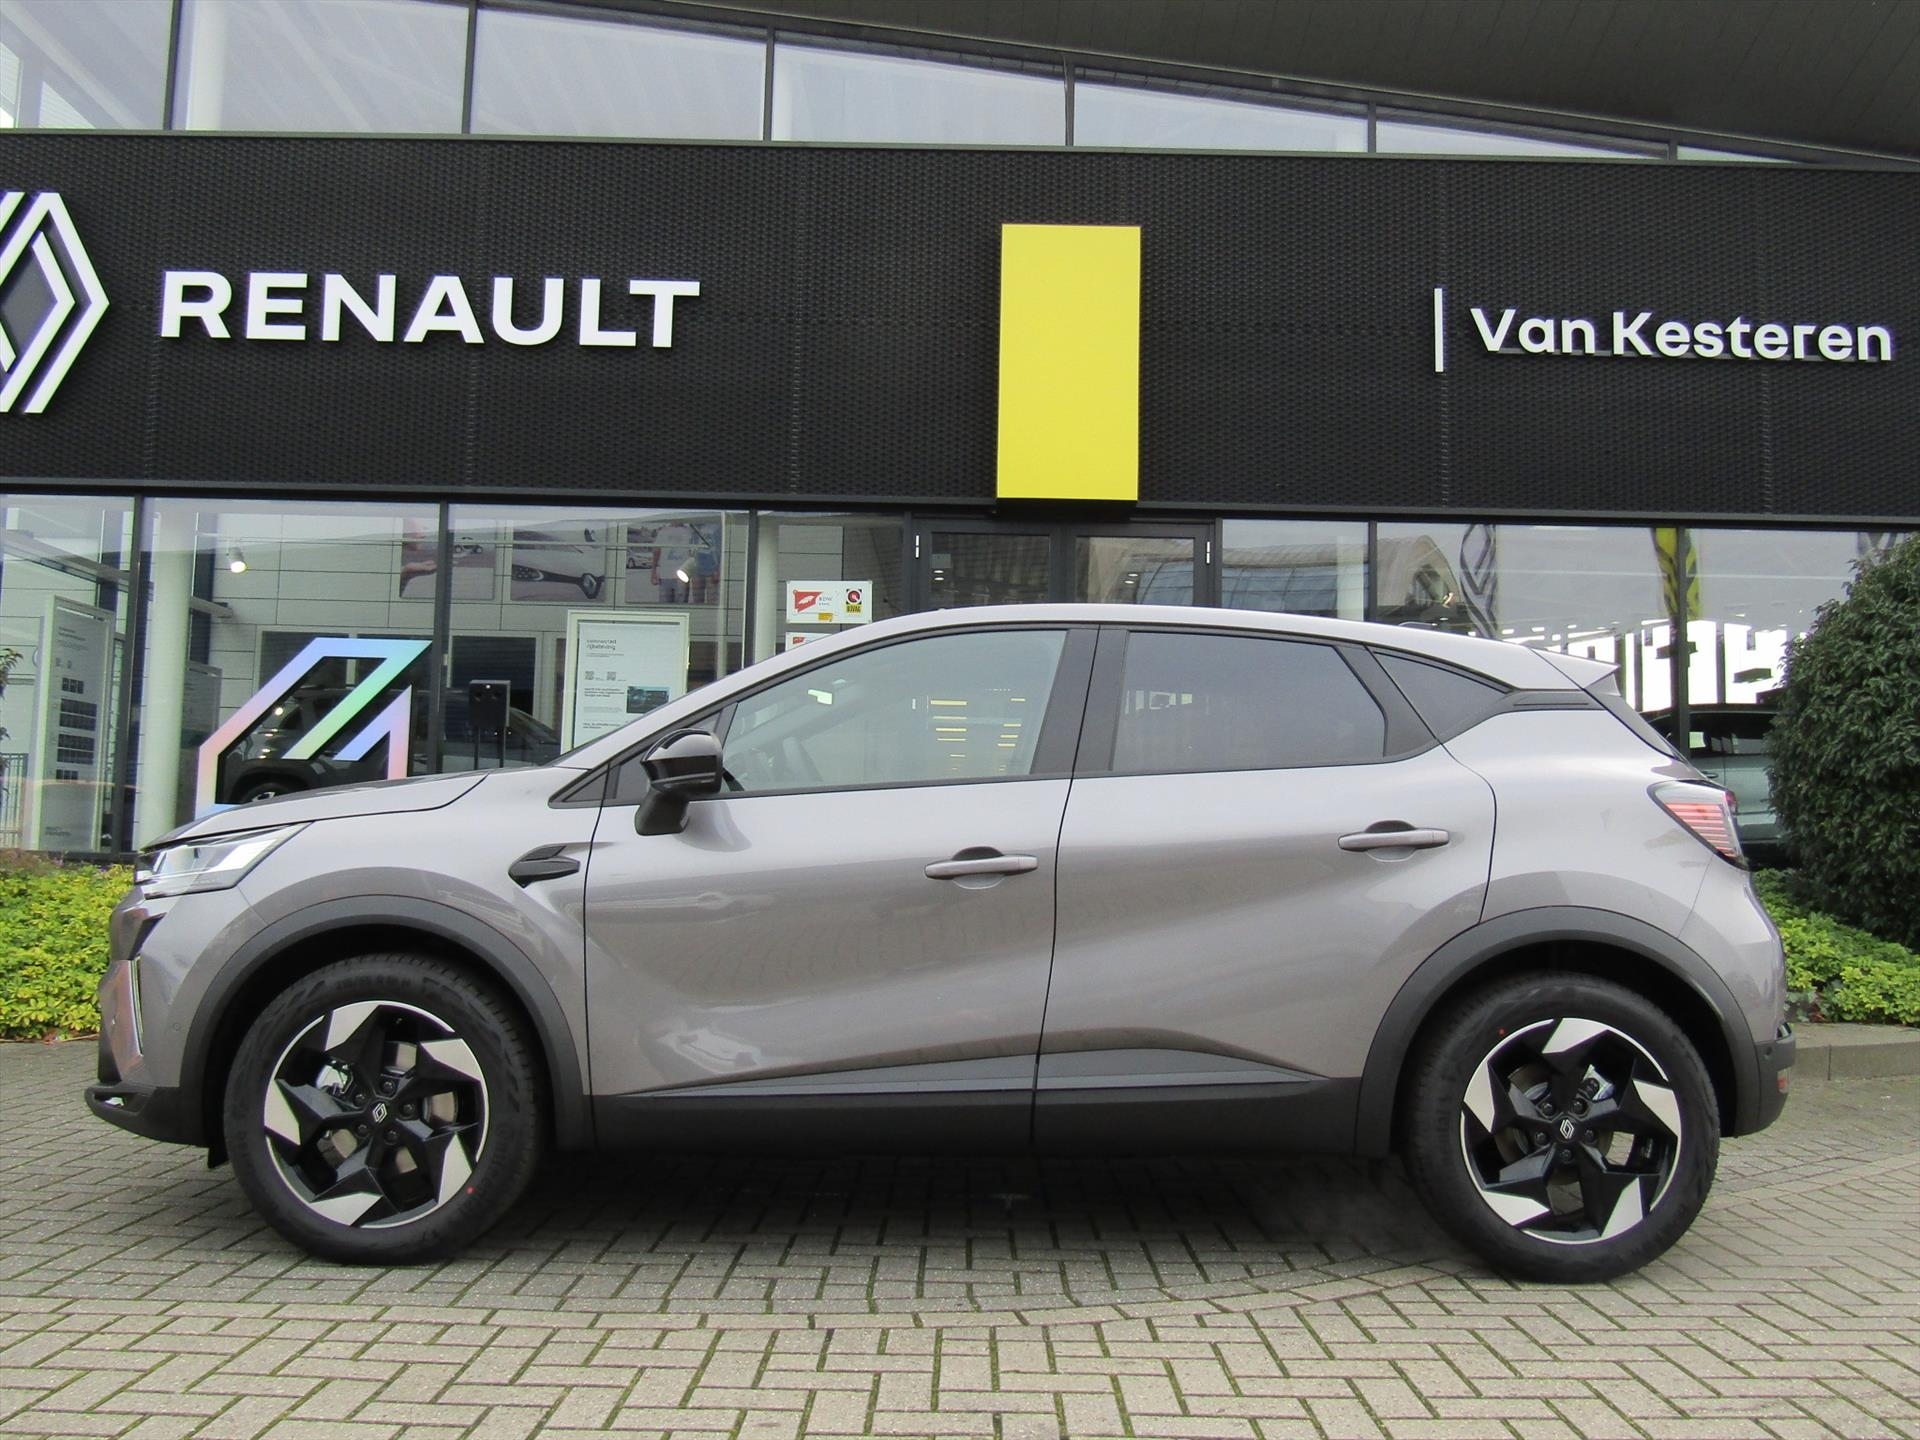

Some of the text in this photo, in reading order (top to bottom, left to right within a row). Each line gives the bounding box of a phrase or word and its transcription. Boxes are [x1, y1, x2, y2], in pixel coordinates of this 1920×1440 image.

[161, 271, 700, 347] RENAULT
[1471, 309, 1891, 360] Van Kesteren
